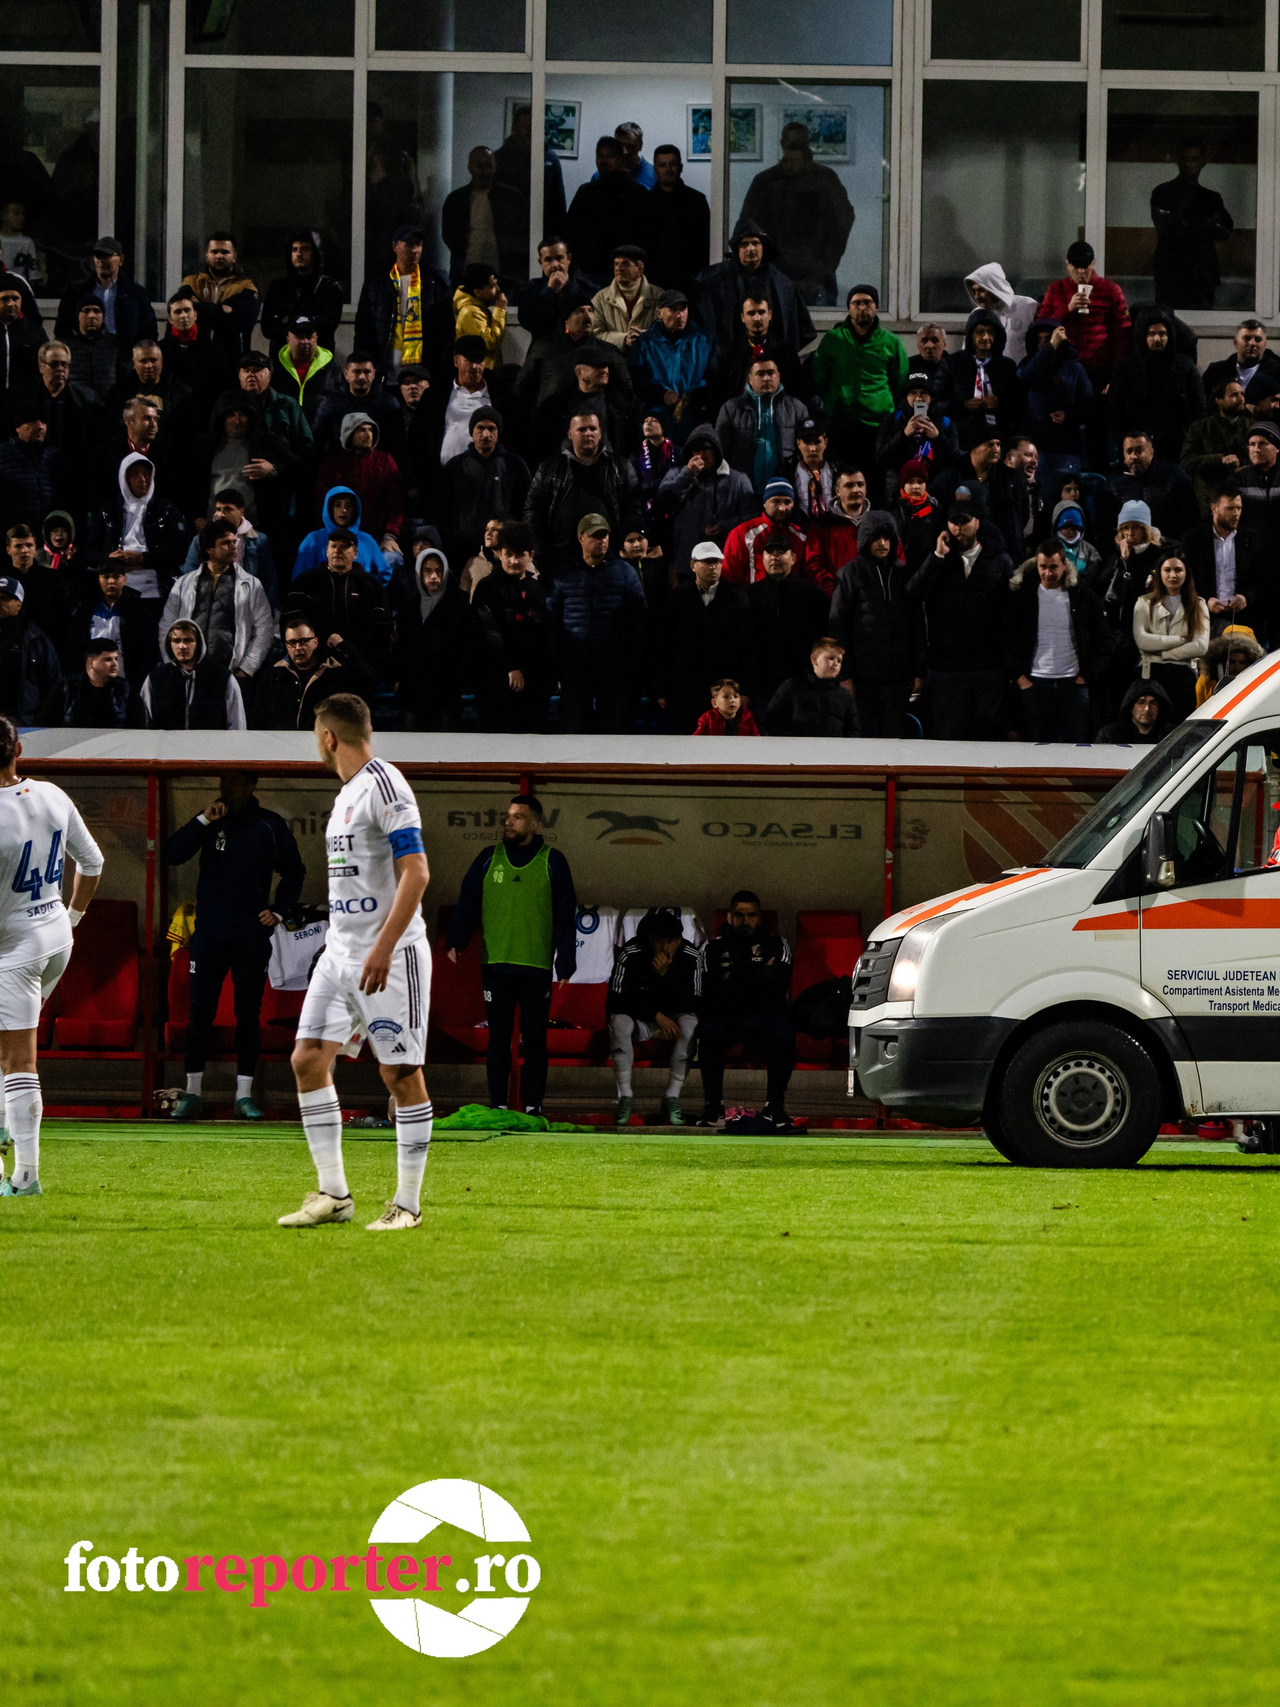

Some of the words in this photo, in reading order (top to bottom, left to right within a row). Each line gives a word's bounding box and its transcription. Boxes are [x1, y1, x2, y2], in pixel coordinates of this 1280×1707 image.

[12, 829, 63, 901] 44
[493, 870, 504, 883] 98
[294, 925, 323, 940] SERONI
[1167, 970, 1220, 981] SERVICIUL
[1222, 970, 1276, 982] JUDETEAN
[1162, 985, 1223, 998] Compartiment
[1224, 986, 1265, 996] Asistenta
[1208, 1000, 1250, 1013] Transport
